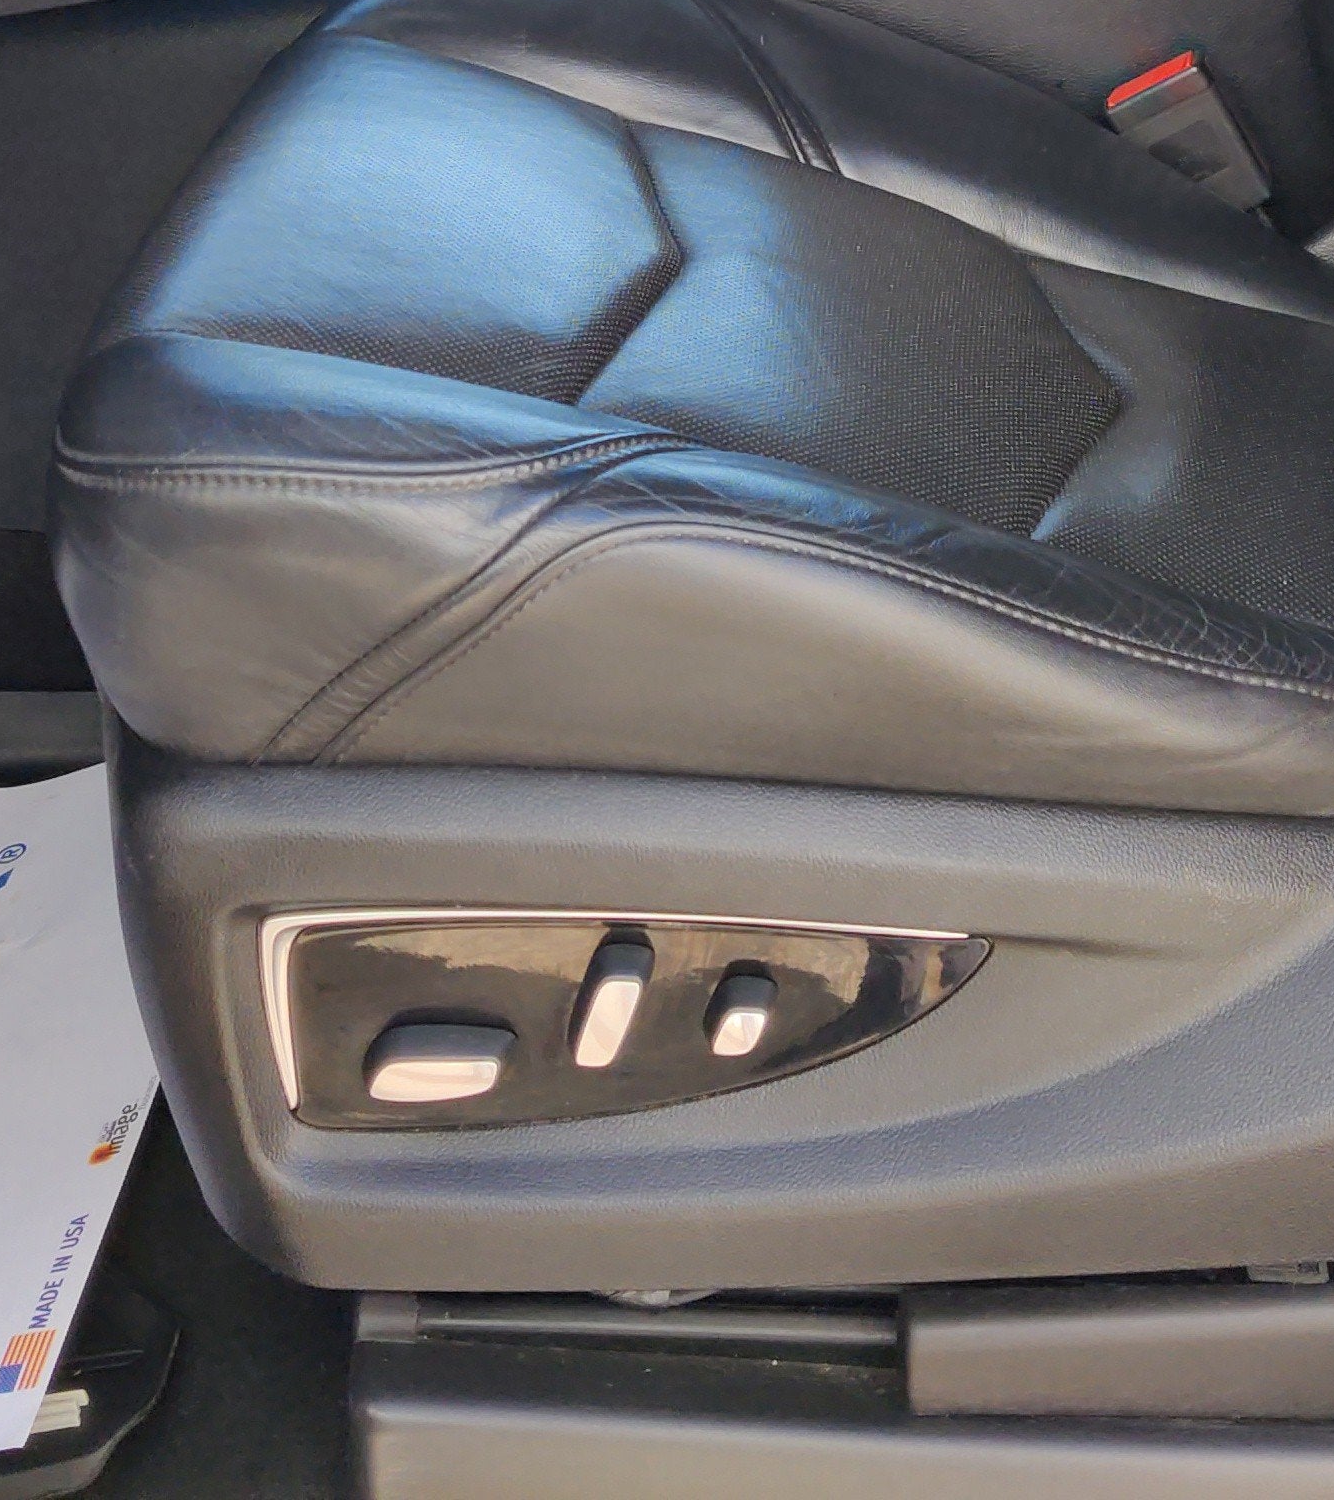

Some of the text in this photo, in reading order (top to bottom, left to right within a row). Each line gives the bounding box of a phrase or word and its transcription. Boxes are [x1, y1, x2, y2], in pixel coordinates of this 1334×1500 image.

[29, 1213, 90, 1329] MADE IN USA
